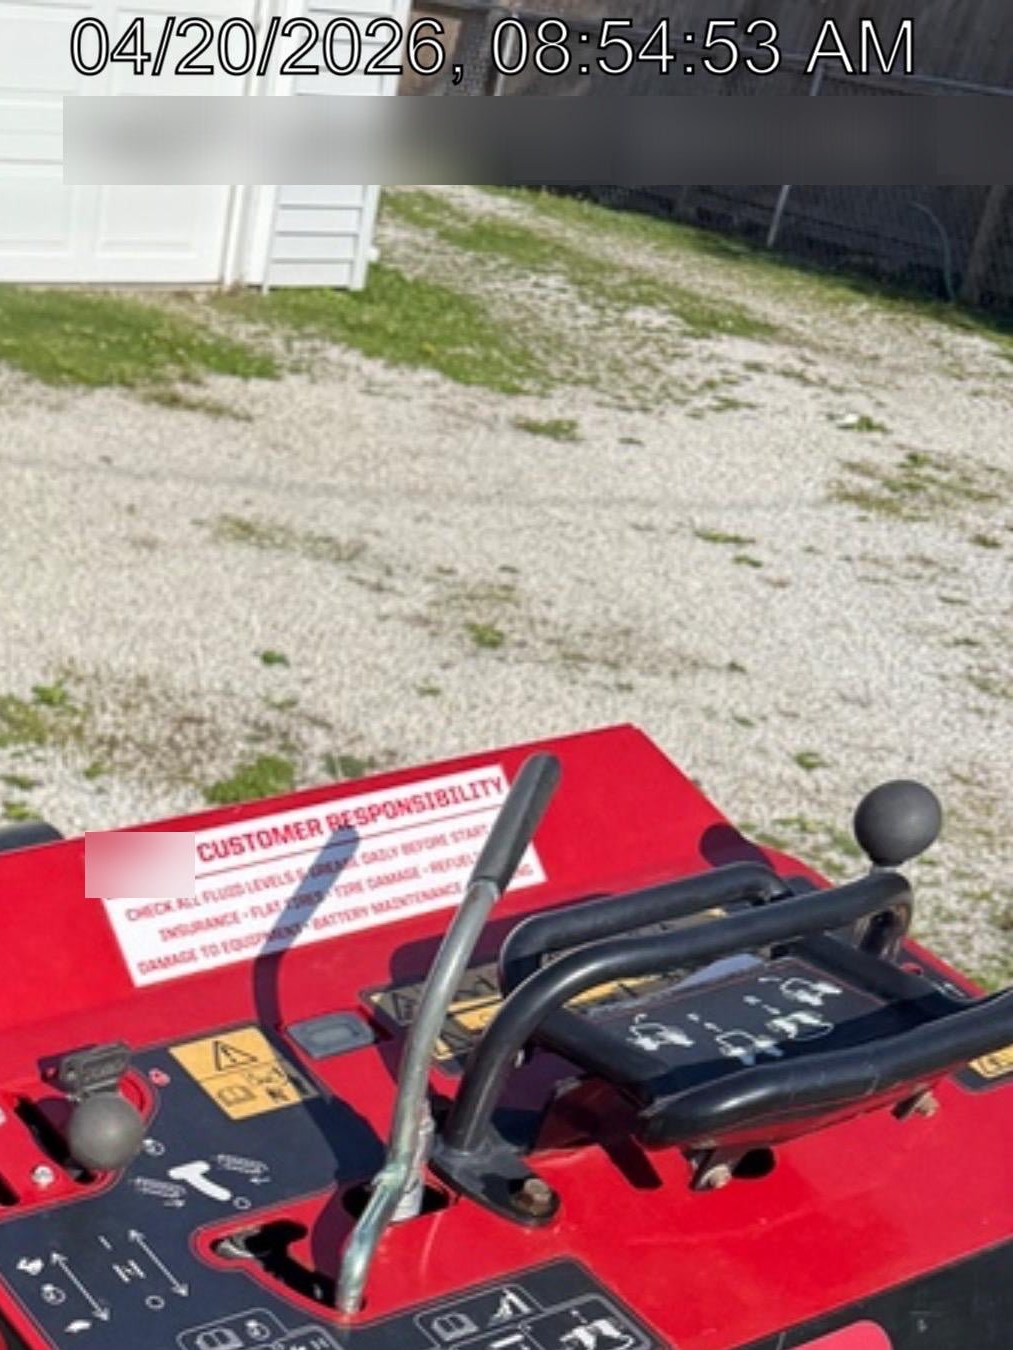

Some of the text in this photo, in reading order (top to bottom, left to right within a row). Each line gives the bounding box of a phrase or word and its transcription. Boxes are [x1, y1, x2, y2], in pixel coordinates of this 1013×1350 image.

[196, 776, 503, 862] CUSTOMER RESPONSIBILITY
[125, 901, 173, 921] CHECK
[202, 885, 243, 903] FLUID
[245, 871, 293, 893] LEVELS
[361, 846, 399, 864] DAILY
[401, 835, 448, 854] BEFORE
[159, 911, 241, 940] INSURANCE
[251, 900, 282, 919] FLAT
[334, 881, 364, 898] TIRE
[368, 867, 420, 890] DAMAGE
[137, 882, 462, 974] DAMAGE TO EQUIPMENT BATTERY MAINTENANCE
